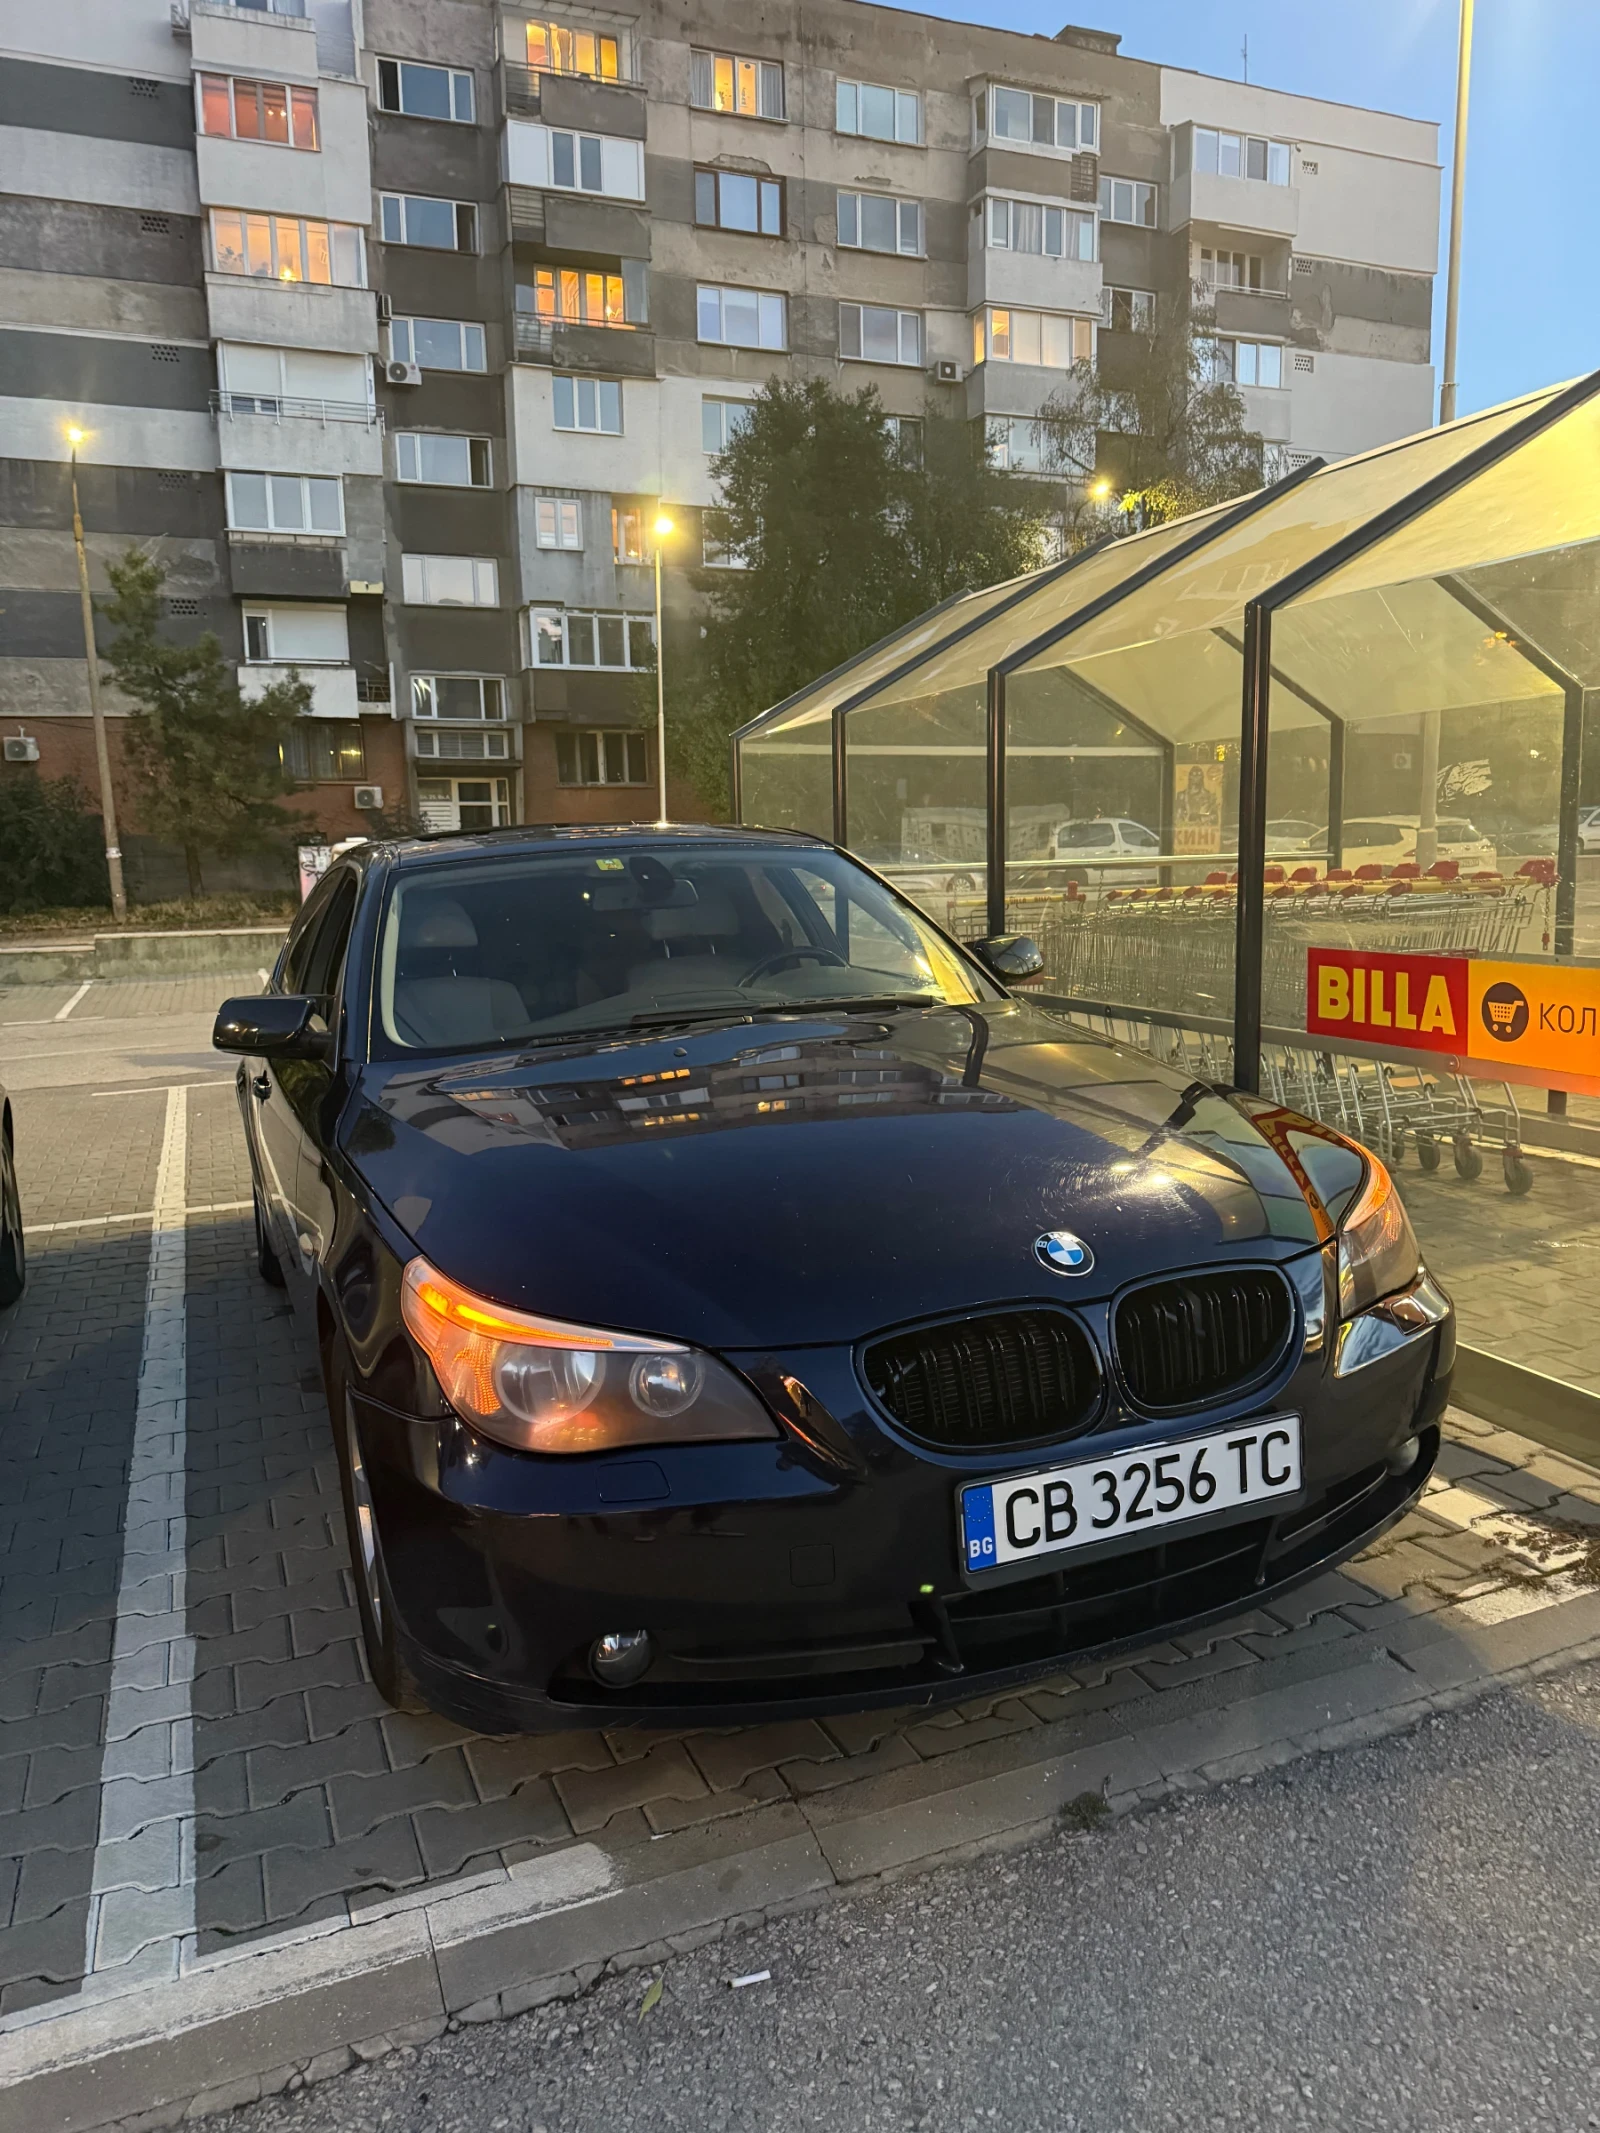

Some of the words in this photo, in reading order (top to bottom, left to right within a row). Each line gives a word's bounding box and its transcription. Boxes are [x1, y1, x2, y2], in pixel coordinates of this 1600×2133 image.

[1318, 965, 1457, 1036] BILLA
[1540, 1002, 1597, 1037] КОЛ
[1005, 1480, 1078, 1549] CB
[1091, 1447, 1218, 1529] 3256
[1228, 1430, 1291, 1494] TC
[969, 1536, 994, 1560] BG
